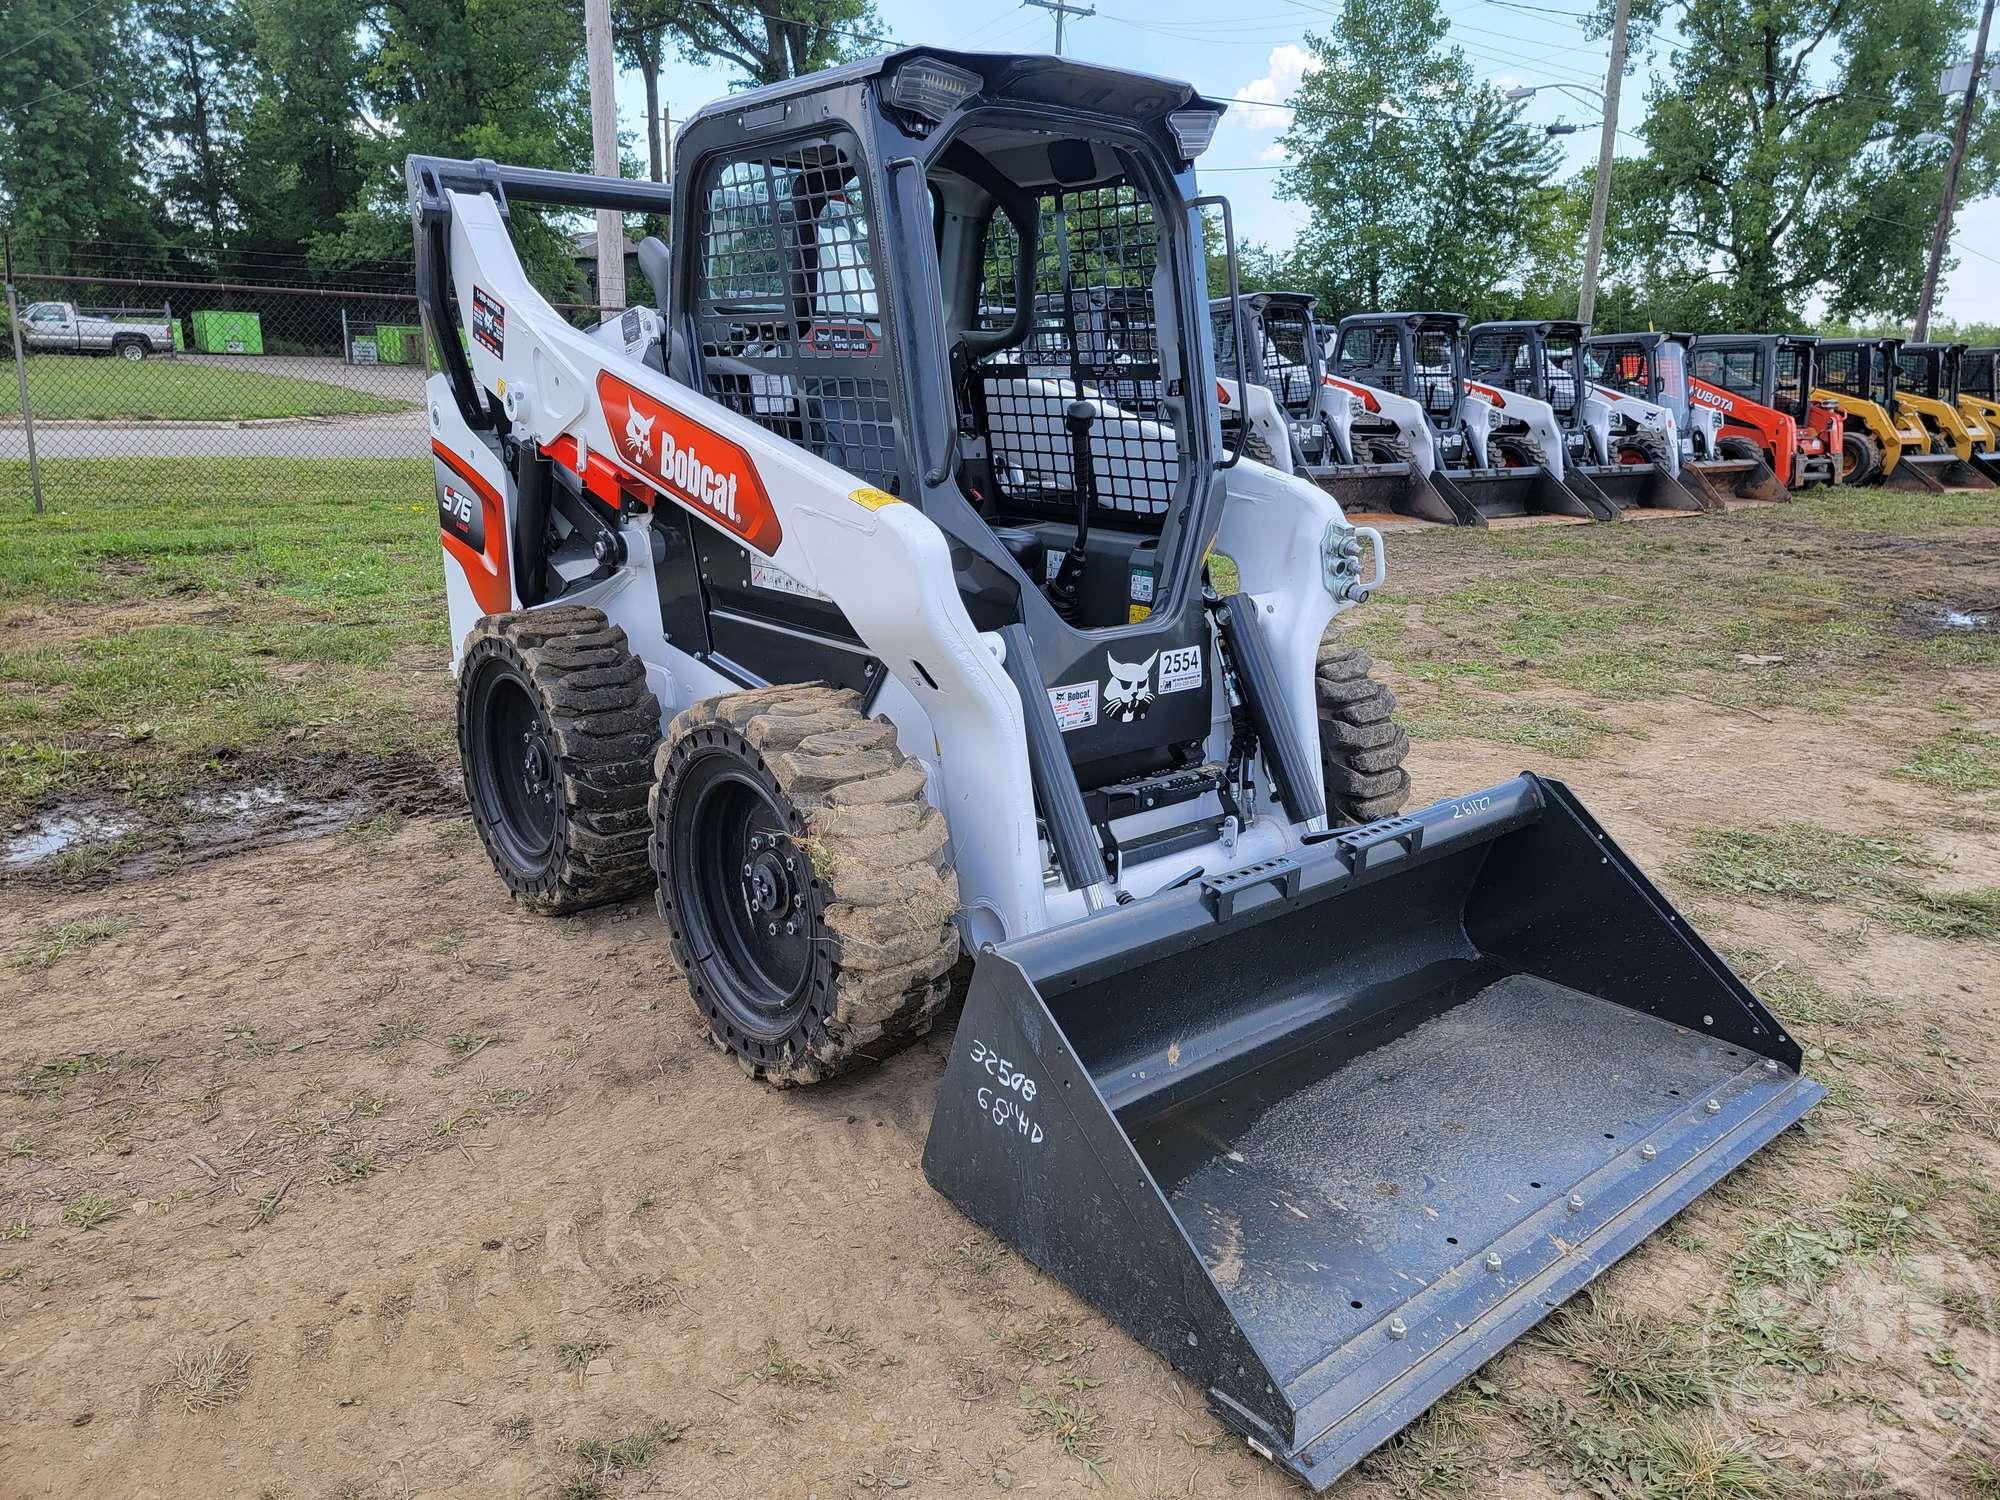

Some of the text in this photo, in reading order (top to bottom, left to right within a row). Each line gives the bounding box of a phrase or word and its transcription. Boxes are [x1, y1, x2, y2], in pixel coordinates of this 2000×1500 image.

[1689, 385, 1734, 412] KUBOTA
[443, 486, 472, 524] S76
[1164, 650, 1199, 675] 2554
[1067, 689, 1090, 702] Bobcat
[970, 1039, 1037, 1102] 32508
